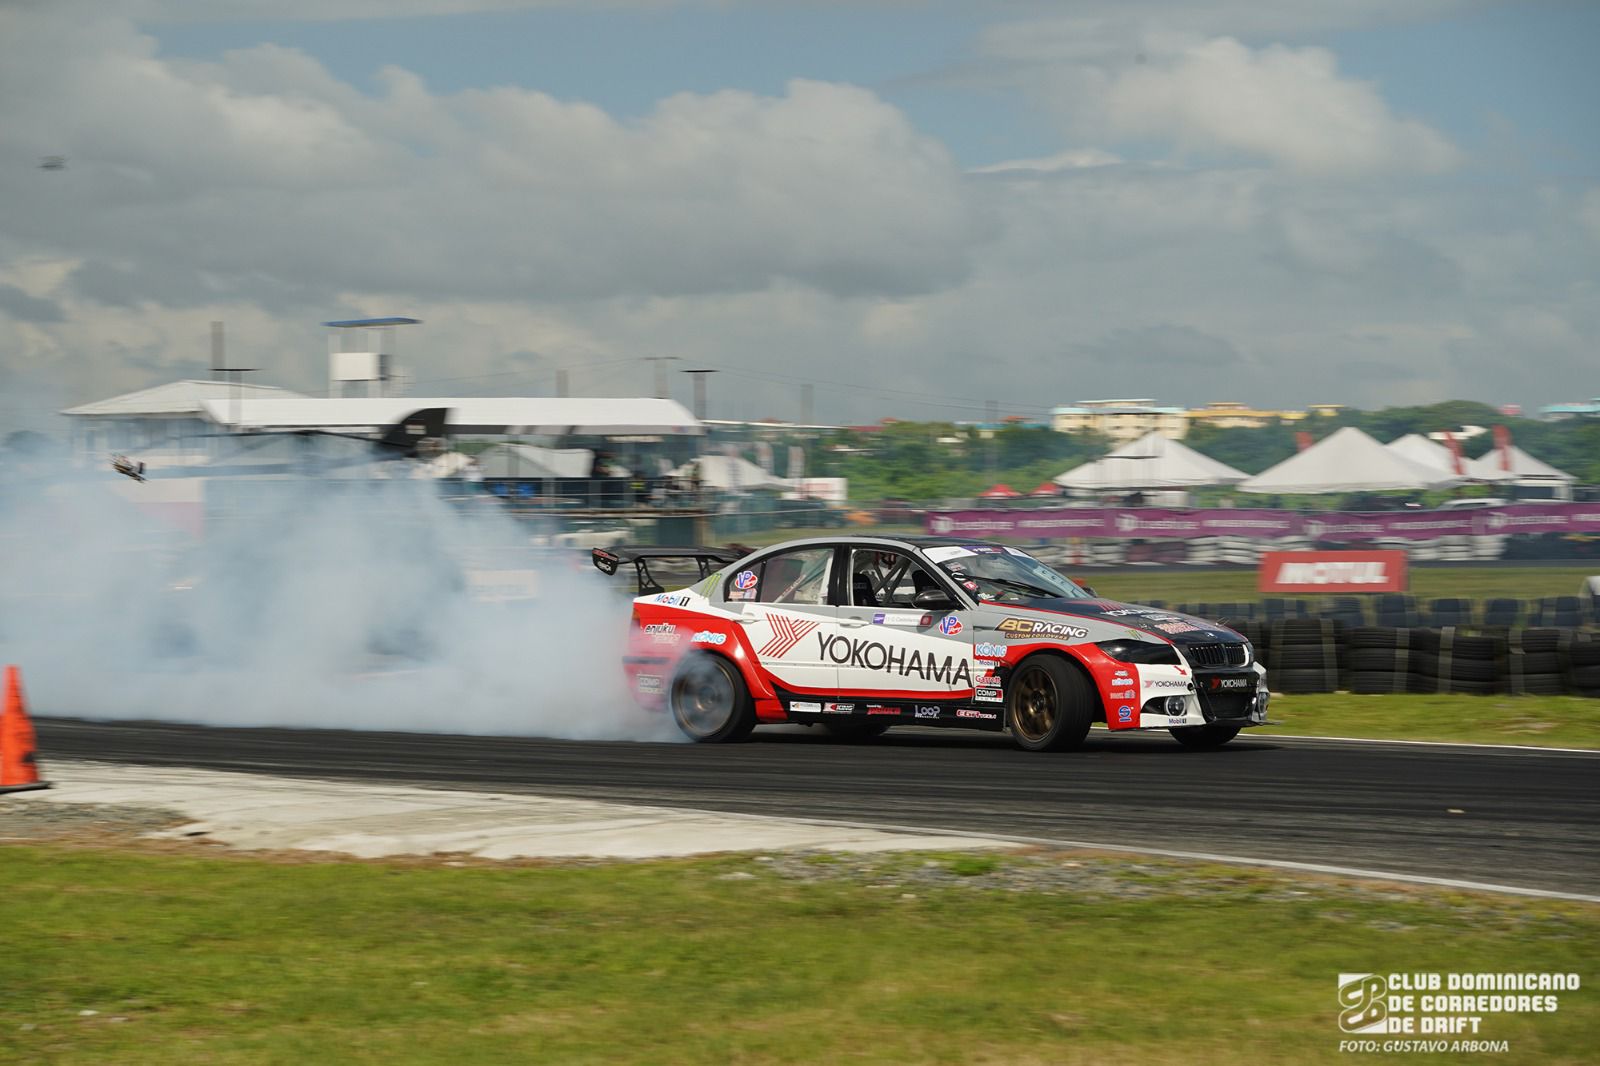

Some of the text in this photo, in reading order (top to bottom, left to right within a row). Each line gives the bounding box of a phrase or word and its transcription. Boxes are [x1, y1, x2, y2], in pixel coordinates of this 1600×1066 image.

[1276, 562, 1388, 584] MOTUL
[653, 594, 690, 607] Mobil 1
[942, 616, 957, 635] VP
[817, 631, 973, 687] YOKOHAMA
[1220, 678, 1248, 688] YOKOHAMA
[977, 689, 997, 697] COMP
